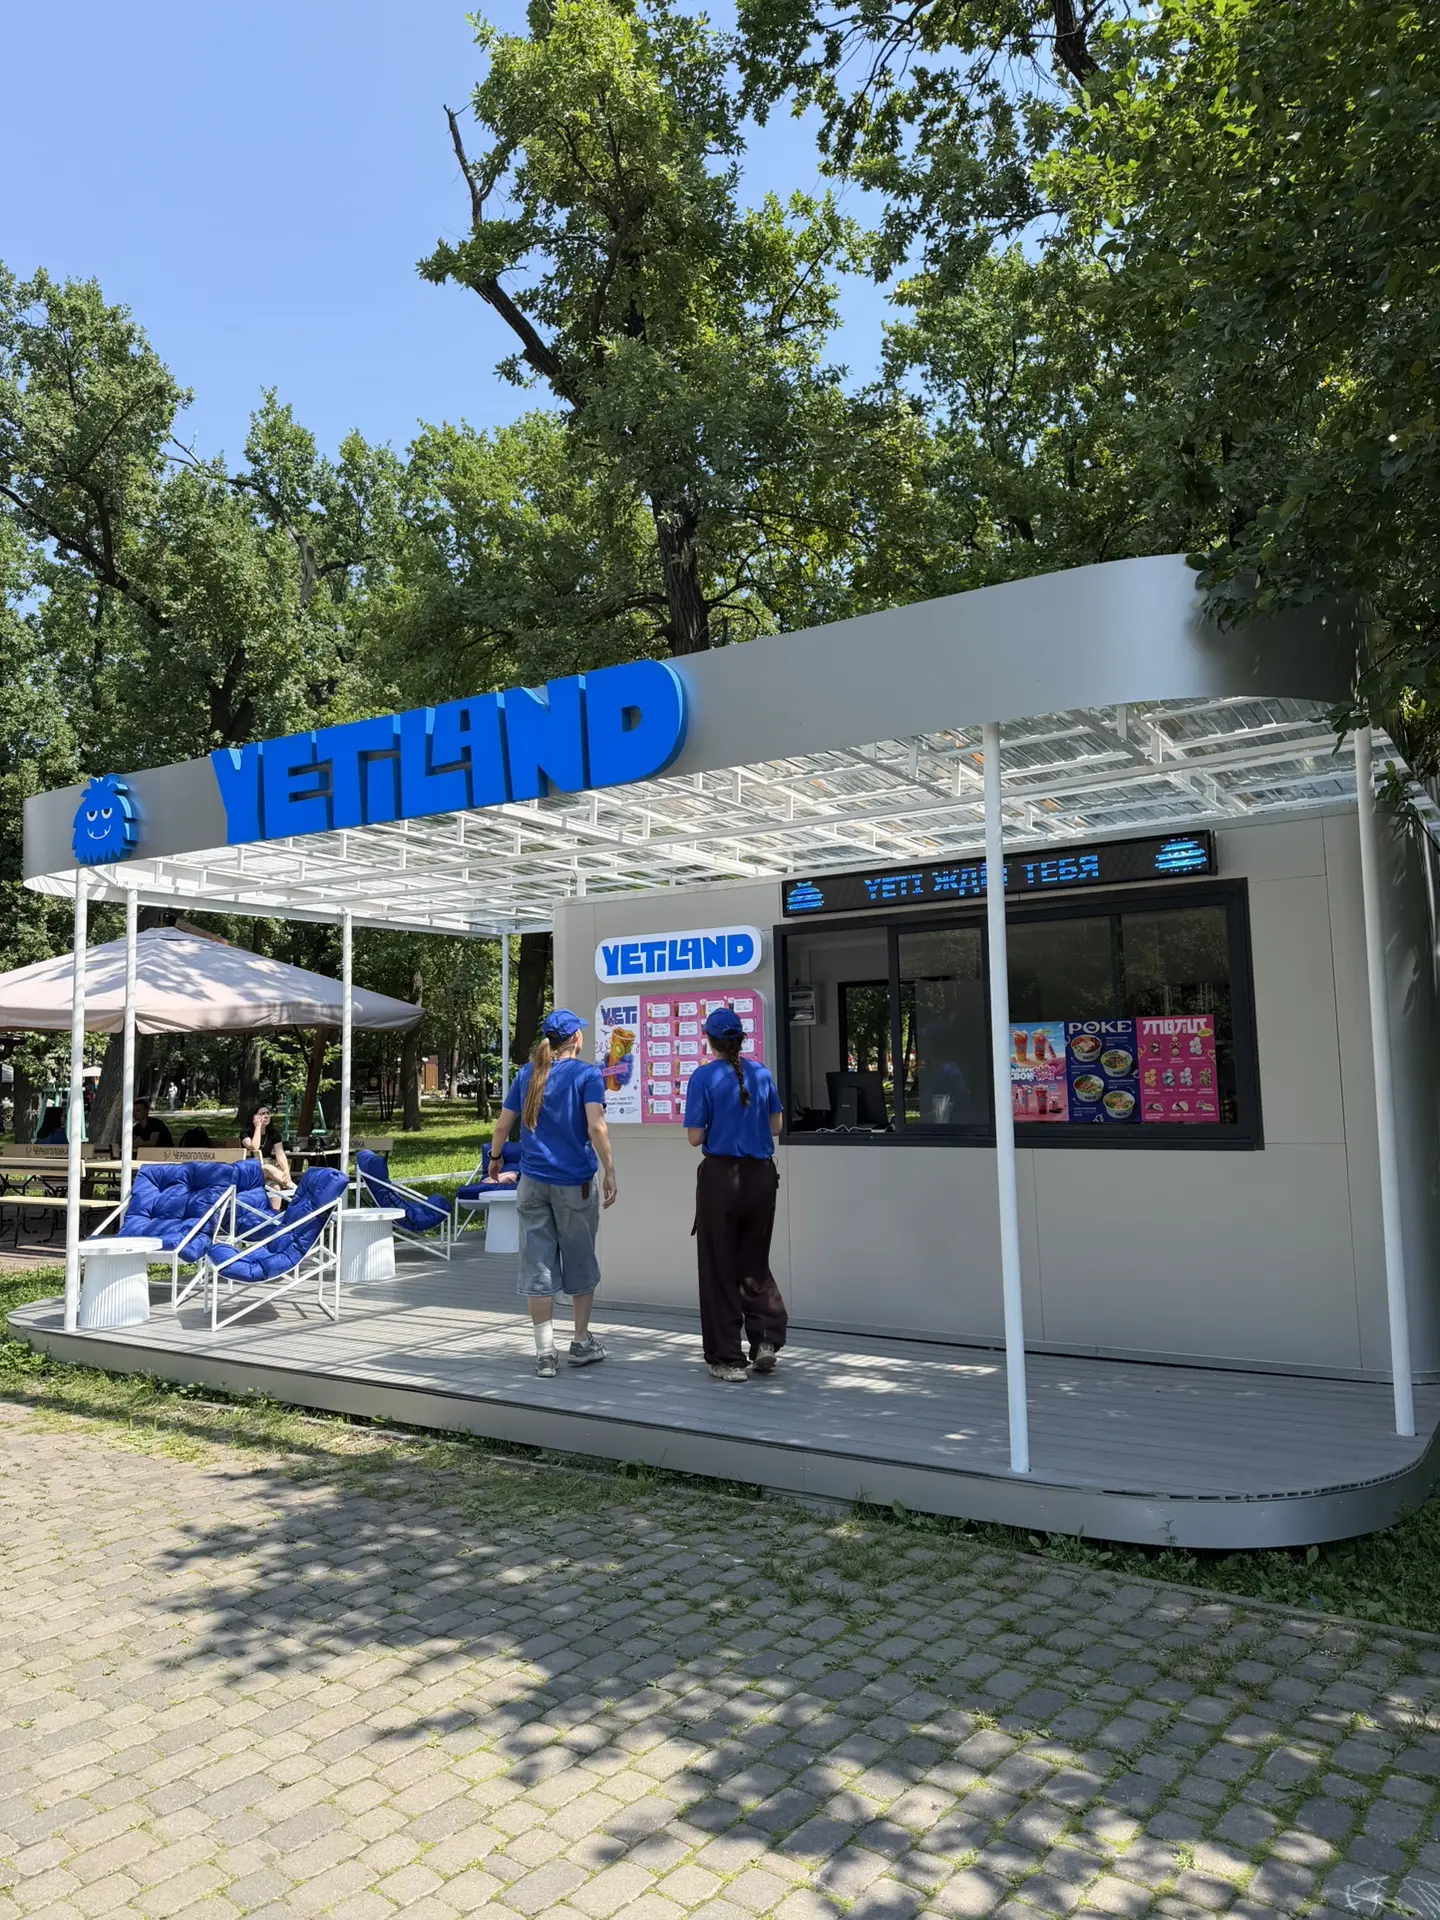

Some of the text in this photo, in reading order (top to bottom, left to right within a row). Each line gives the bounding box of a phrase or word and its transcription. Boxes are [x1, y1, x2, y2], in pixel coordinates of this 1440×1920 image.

[211, 658, 688, 844] YETILAND
[1022, 854, 1099, 883] ТЕБЯ
[602, 933, 754, 976] YETILAND
[1069, 1021, 1132, 1034] POKE
